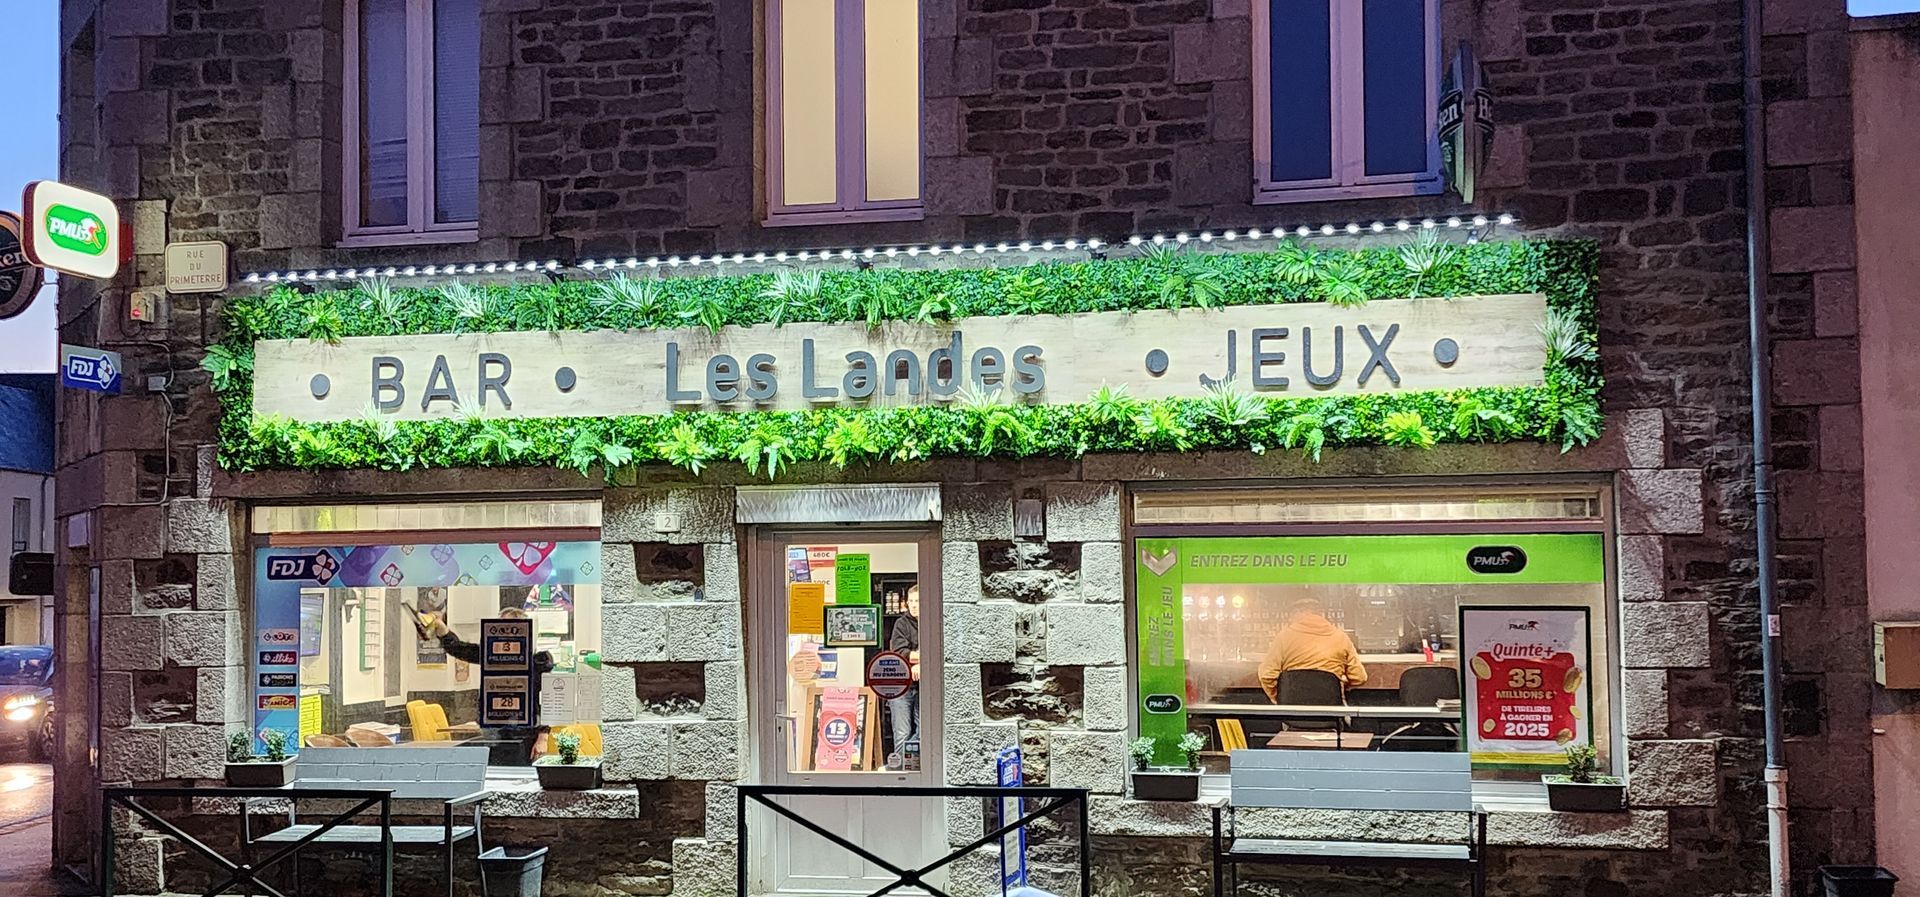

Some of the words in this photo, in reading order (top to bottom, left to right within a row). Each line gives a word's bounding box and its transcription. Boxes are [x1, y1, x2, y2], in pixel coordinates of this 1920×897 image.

[50, 217, 83, 240] PMU
[187, 250, 204, 259] RUE
[190, 263, 202, 271] DU
[170, 274, 222, 285] PRIMETERRE
[70, 359, 94, 377] FDJ
[371, 352, 513, 411] BAR
[666, 342, 778, 402] Les
[802, 330, 1047, 399] Landes
[1199, 323, 1401, 390] JEUX
[664, 516, 672, 528] 2
[270, 559, 305, 576] FDJ
[1190, 555, 1248, 568] ENTREZ
[1253, 555, 1295, 567] DANS
[1300, 554, 1316, 567] LE
[1320, 554, 1348, 567] JEU
[1473, 556, 1500, 566] PMU
[1162, 586, 1174, 608] JEU
[1163, 611, 1174, 626] LE
[1493, 642, 1554, 658] Quinté+
[1508, 668, 1542, 688] 35
[1495, 690, 1544, 699] MILLIONS
[829, 722, 847, 735] 13
[1504, 723, 1550, 737] 2025
